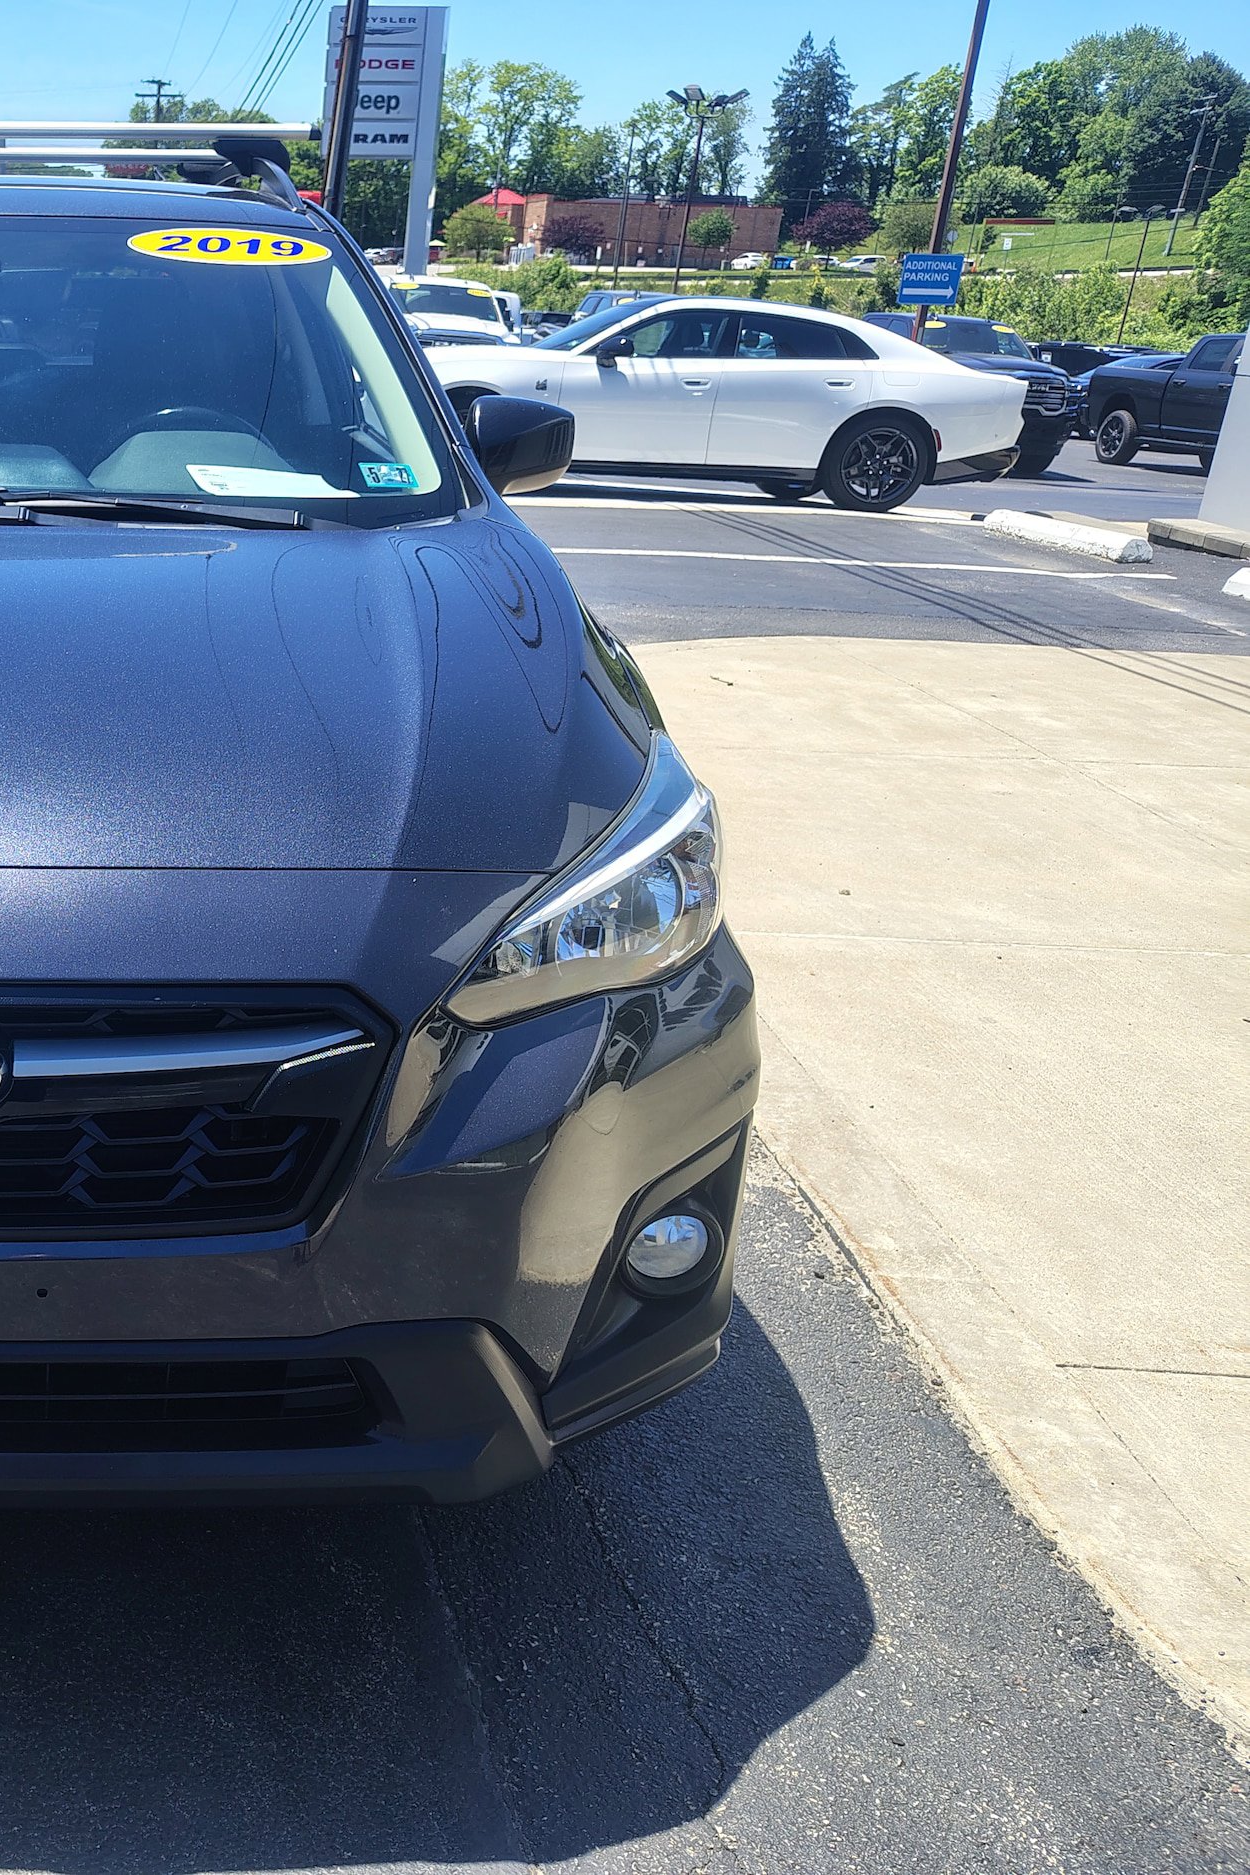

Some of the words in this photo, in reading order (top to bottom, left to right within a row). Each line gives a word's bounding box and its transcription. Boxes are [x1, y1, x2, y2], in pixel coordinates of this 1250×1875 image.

[353, 133, 409, 144] RAM
[157, 235, 304, 257] 2019
[905, 261, 958, 271] ADDITIONAL
[903, 272, 950, 282] PARKING
[367, 467, 381, 484] 5
